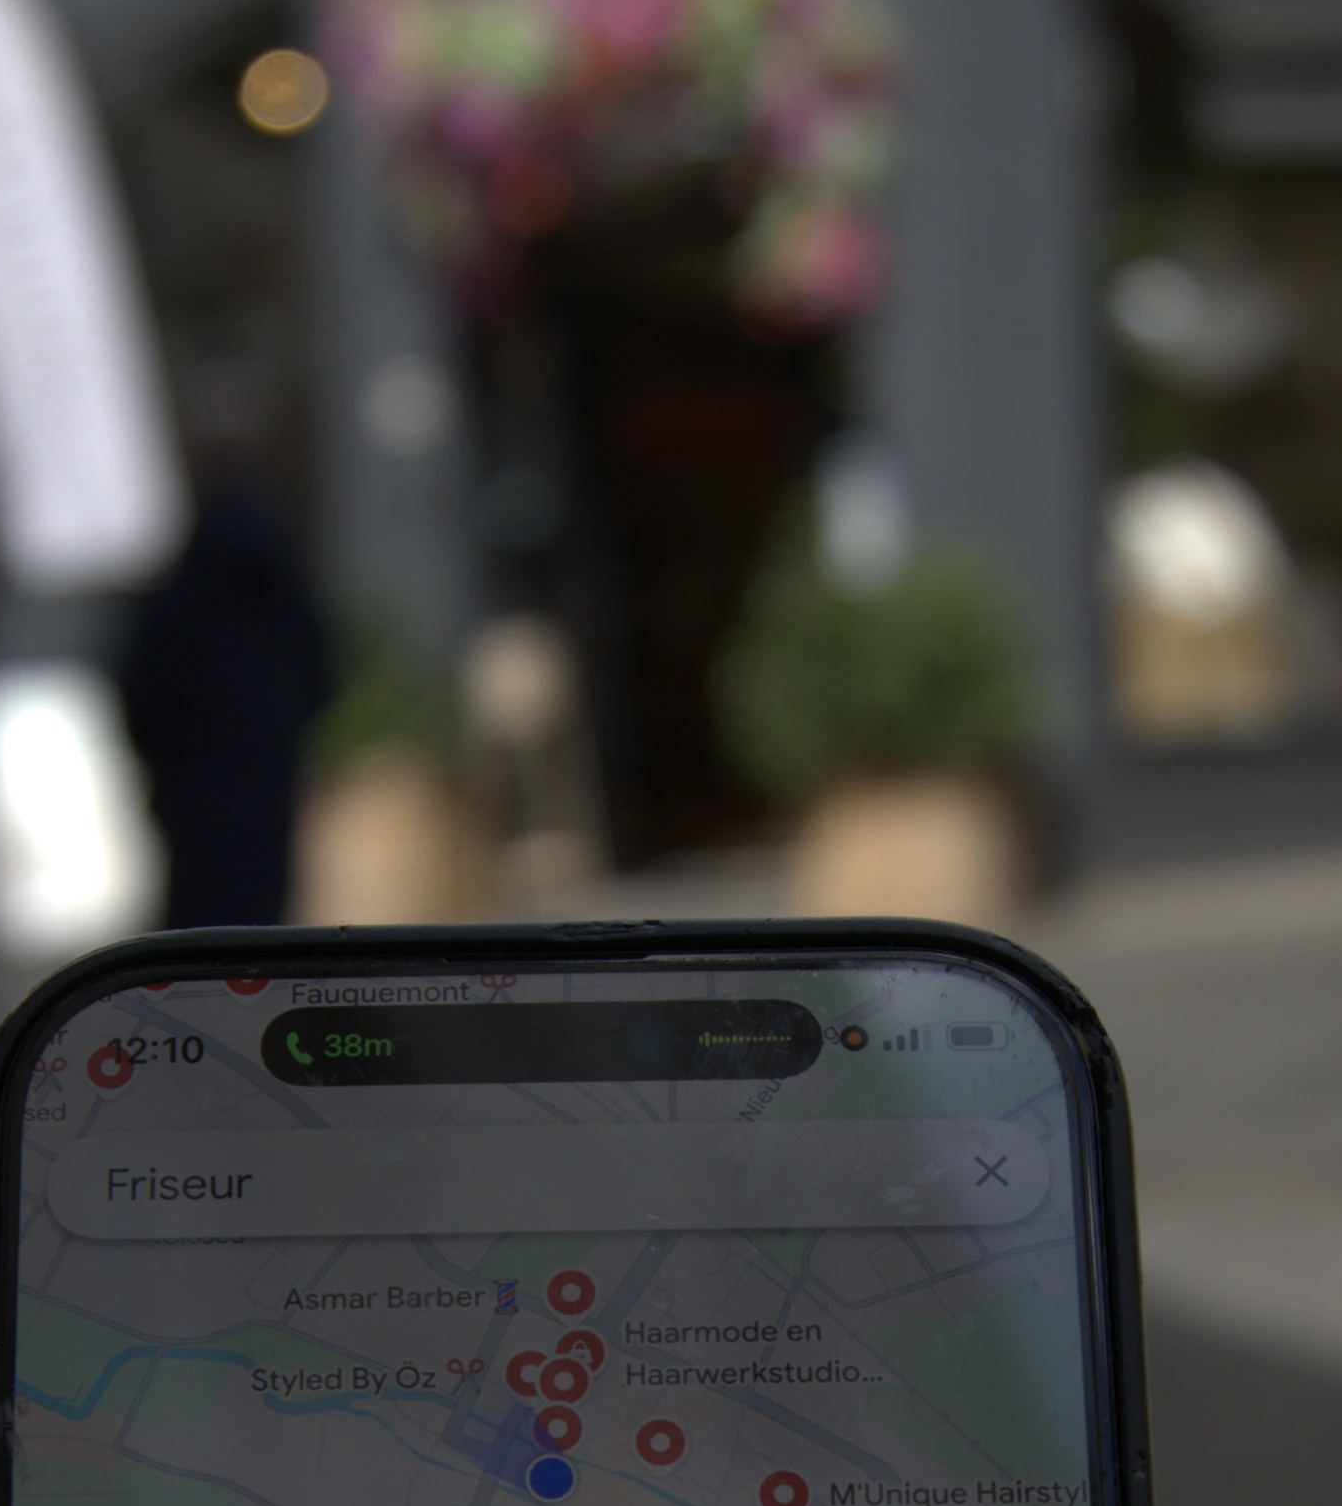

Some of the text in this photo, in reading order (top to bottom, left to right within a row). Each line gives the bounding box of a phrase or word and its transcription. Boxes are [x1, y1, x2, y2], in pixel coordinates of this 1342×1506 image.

[291, 983, 469, 1007] Fauquemont
[105, 1035, 205, 1067] 12:10
[322, 1032, 393, 1059] 38m
[107, 1167, 253, 1201] Friseur
[283, 1285, 485, 1311] Asmar Barber
[625, 1320, 822, 1344] Haarmode en
[251, 1361, 437, 1398] Styled By Öz
